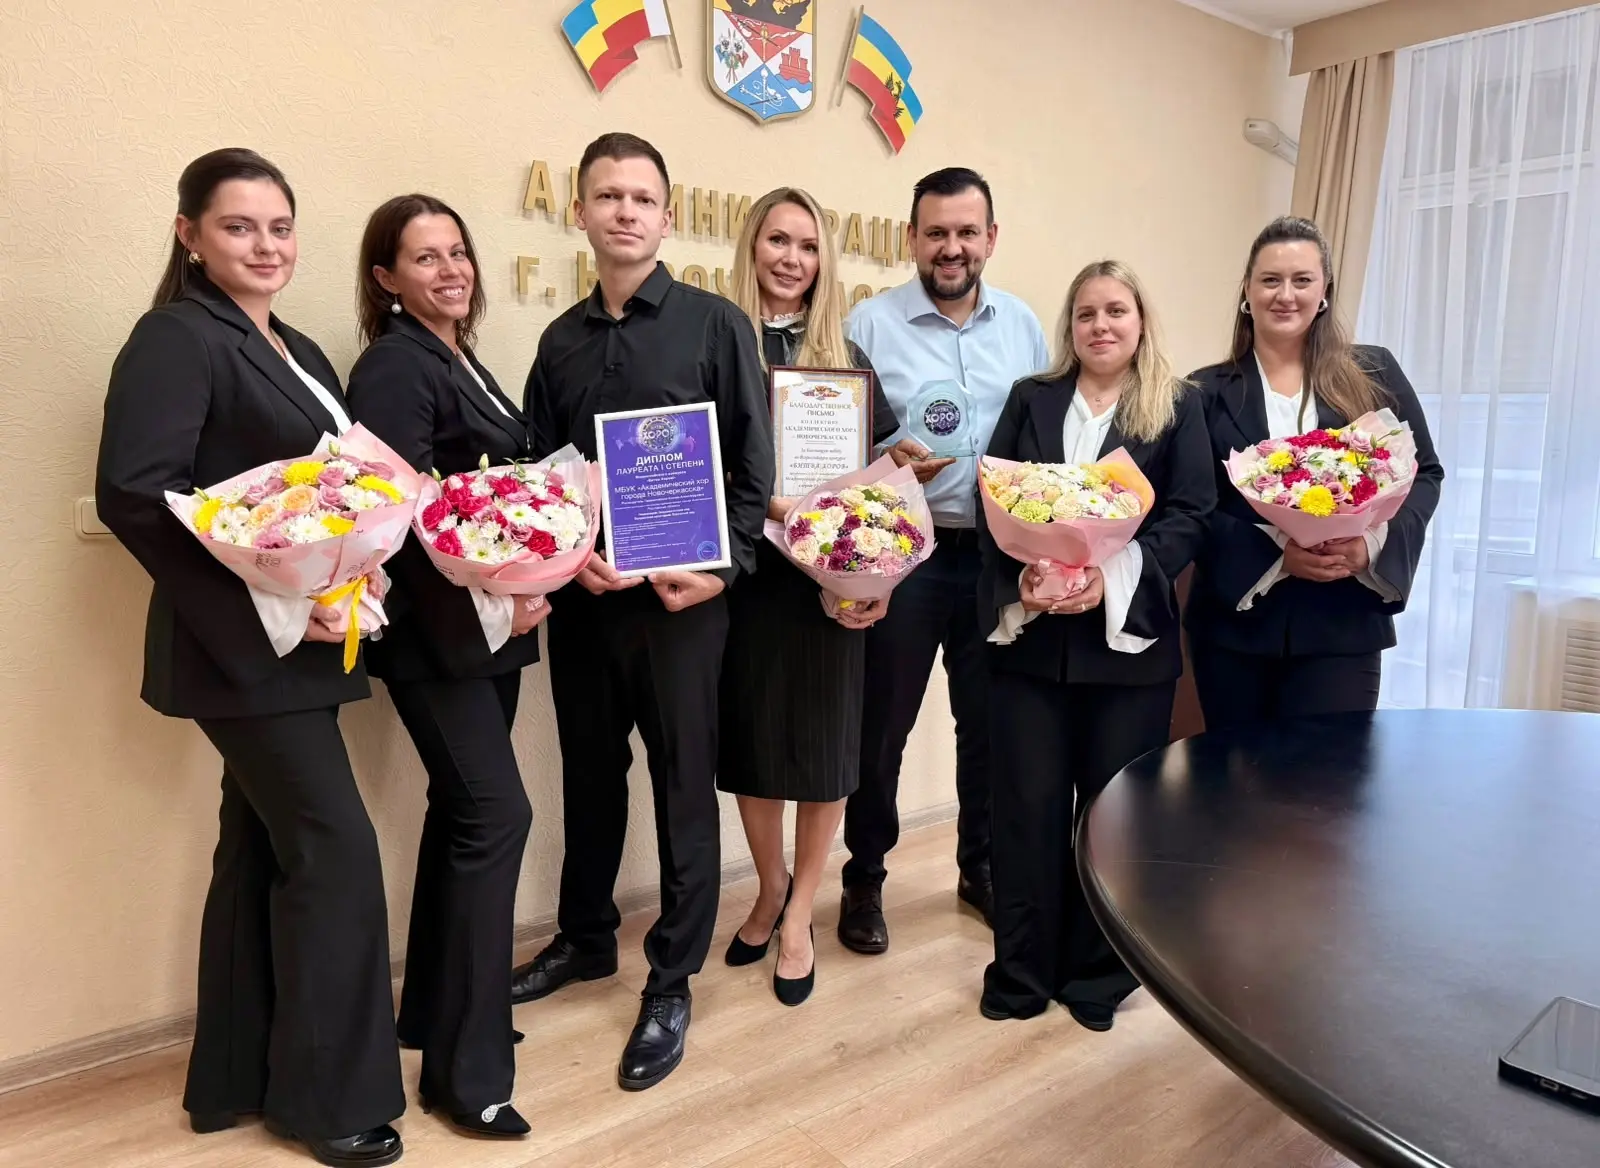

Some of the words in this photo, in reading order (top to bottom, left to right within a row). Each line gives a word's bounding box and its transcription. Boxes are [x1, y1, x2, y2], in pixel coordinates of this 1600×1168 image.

[636, 452, 683, 466] ДИПЛОМ
[616, 465, 659, 475] ЛАУРЕАТА
[666, 459, 704, 470] СТЕПЕНИ
[621, 492, 646, 500] города
